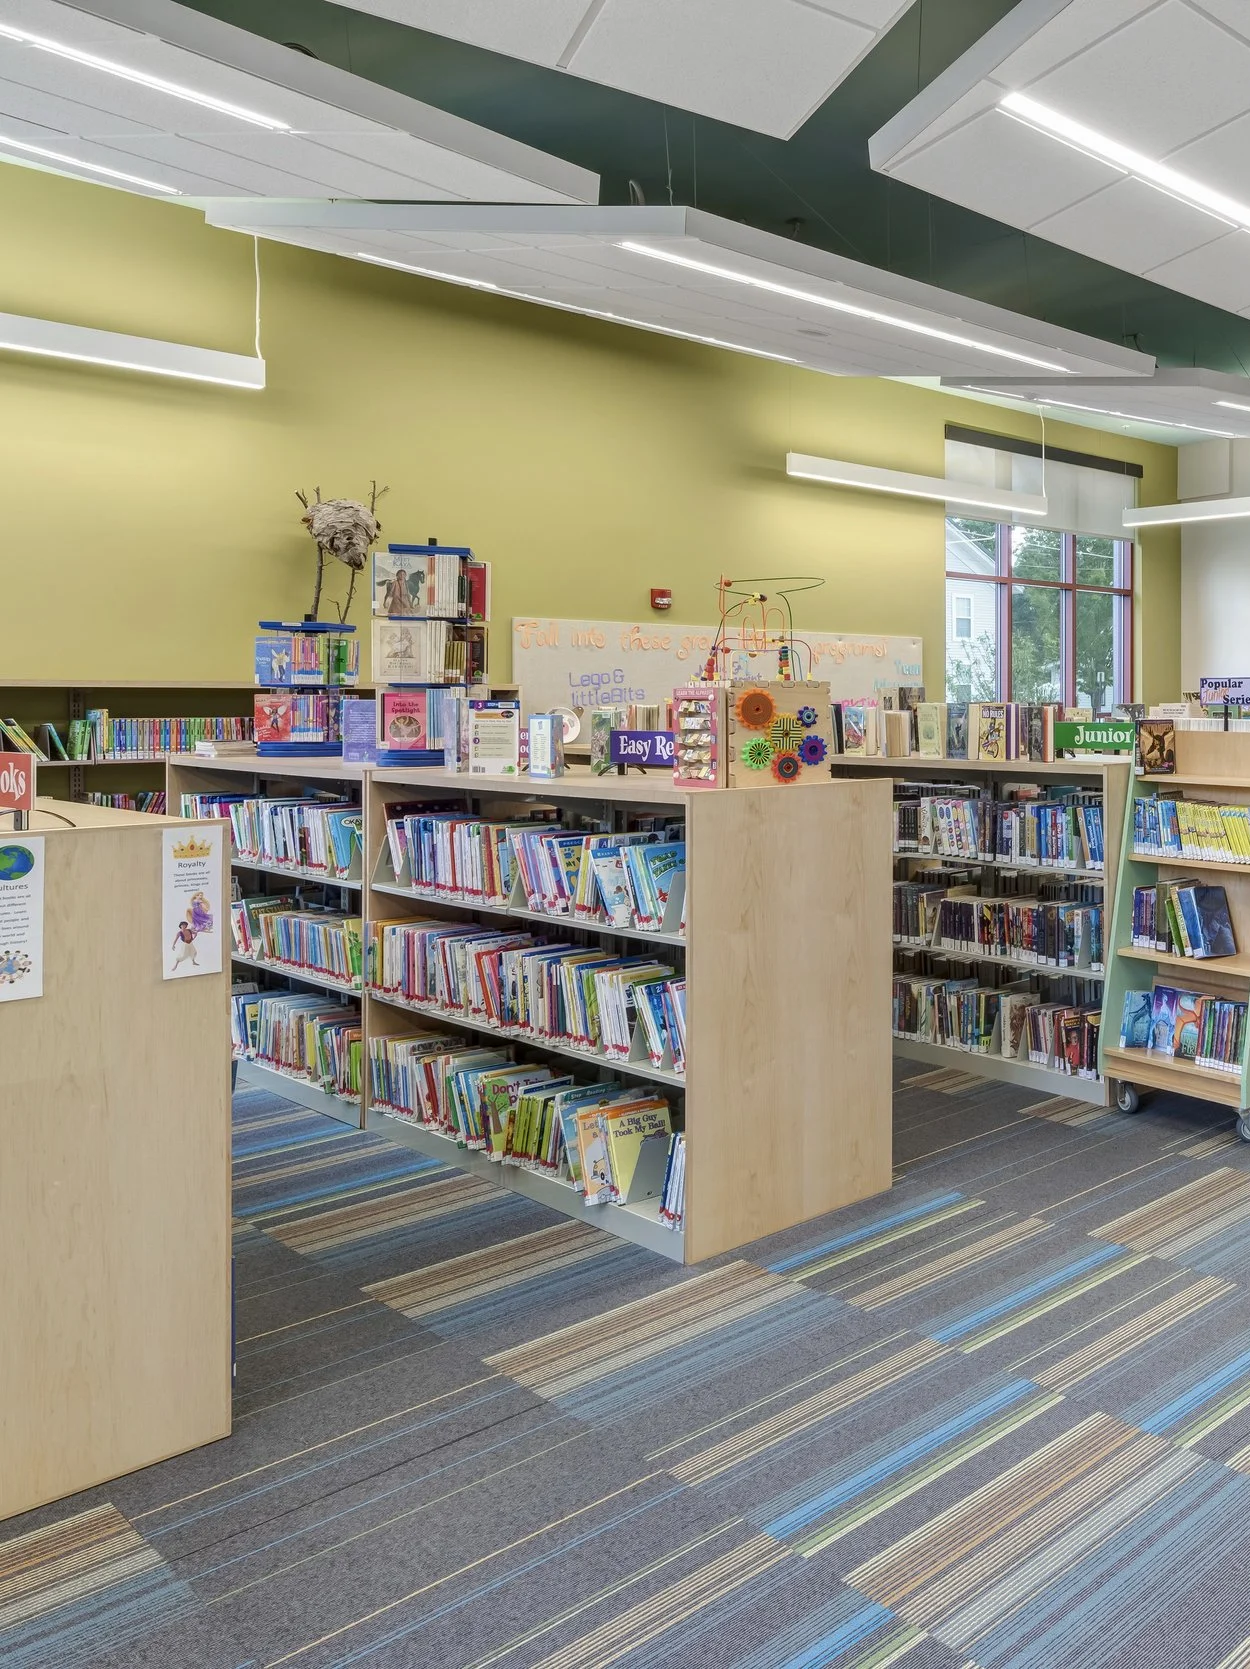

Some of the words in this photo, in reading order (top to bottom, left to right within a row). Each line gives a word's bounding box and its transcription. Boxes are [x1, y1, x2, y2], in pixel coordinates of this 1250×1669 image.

[515, 622, 560, 649] Fall
[571, 627, 606, 648] into
[620, 625, 672, 651] these
[676, 634, 714, 660] grea
[568, 671, 611, 688] Lego
[1201, 679, 1243, 690] Popular
[571, 687, 646, 707] littleBits
[982, 709, 989, 718] NO
[990, 709, 1004, 718] RULES
[1074, 725, 1133, 745] Junior
[618, 735, 651, 761] Easy
[178, 861, 206, 869] Royalty
[492, 1080, 520, 1095] Don't
[613, 1128, 633, 1138] Took
[635, 1125, 646, 1134] My
[648, 1119, 666, 1131] Ball!
[619, 1119, 625, 1128] A
[627, 1117, 641, 1128] Big
[642, 1113, 658, 1124] Guy
